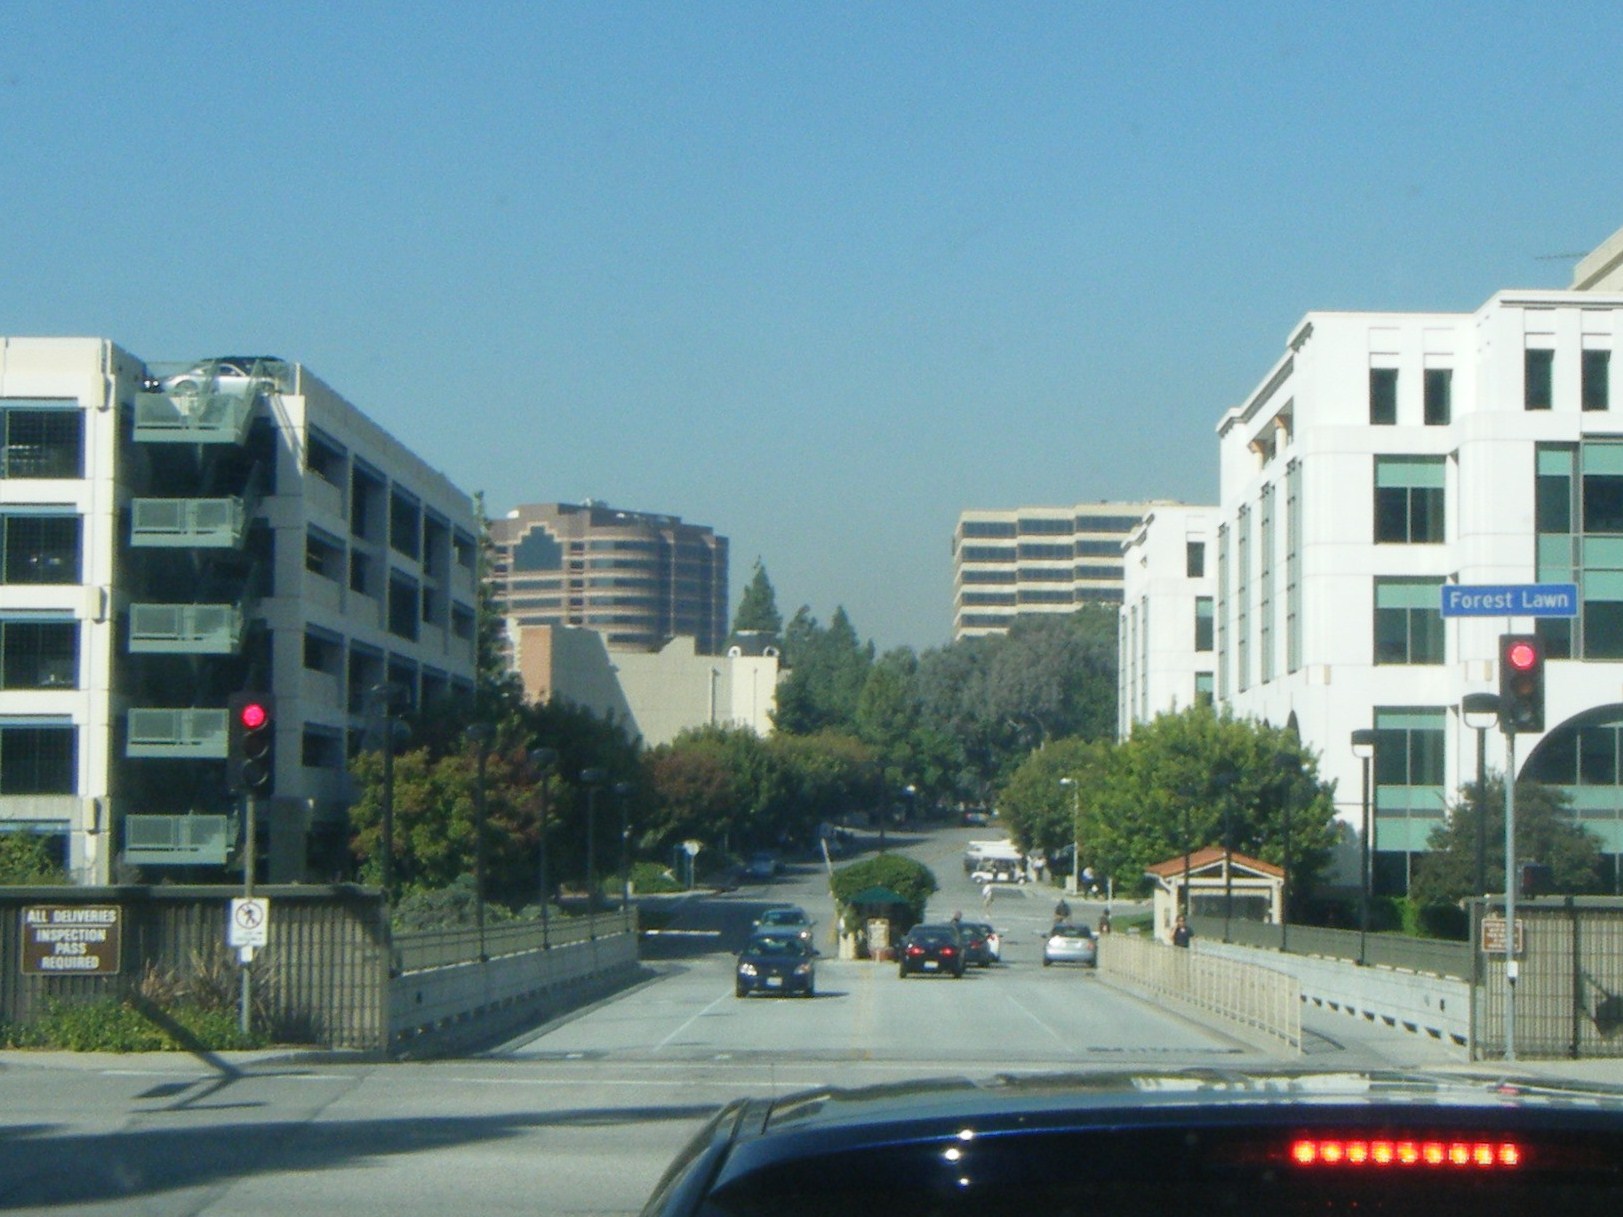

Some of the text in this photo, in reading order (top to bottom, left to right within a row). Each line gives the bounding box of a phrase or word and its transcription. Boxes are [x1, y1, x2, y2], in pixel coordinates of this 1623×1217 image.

[1450, 590, 1569, 609] Forest Lawn
[27, 909, 117, 923] ALL DELIVERIES
[36, 928, 107, 943] INSPECTION
[55, 942, 88, 955] PASS
[41, 955, 100, 970] REQUIRED
